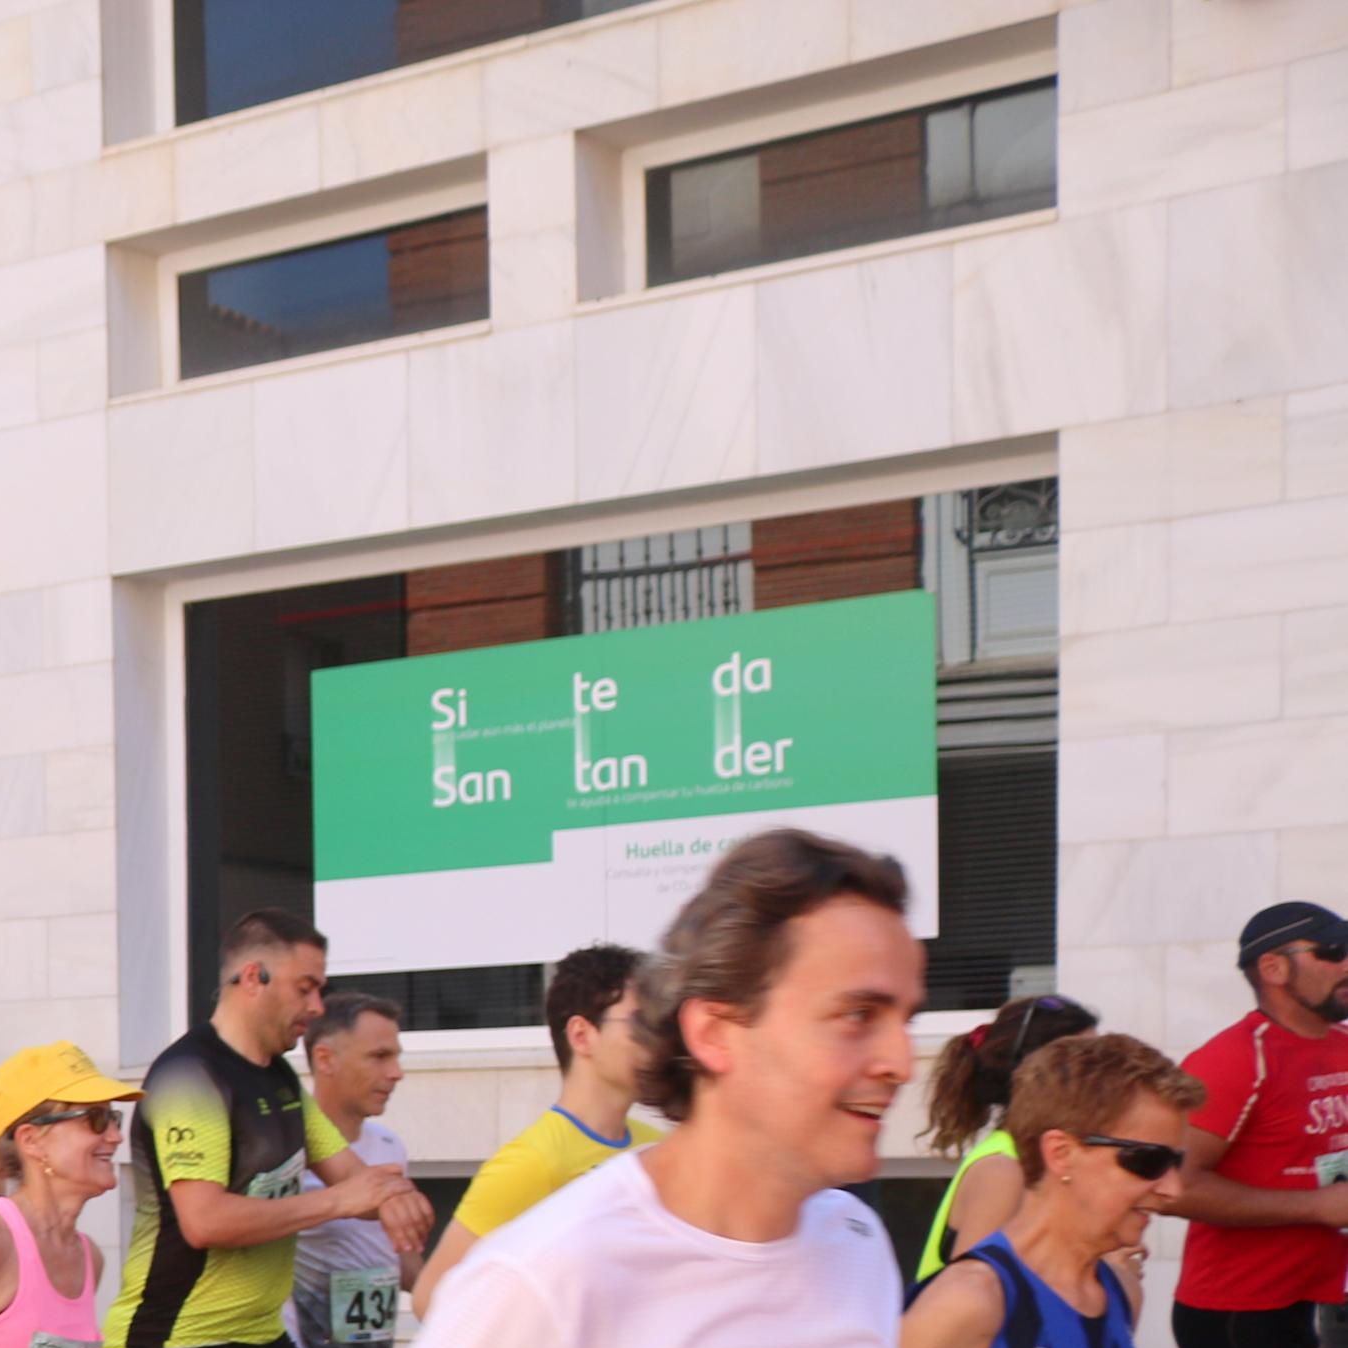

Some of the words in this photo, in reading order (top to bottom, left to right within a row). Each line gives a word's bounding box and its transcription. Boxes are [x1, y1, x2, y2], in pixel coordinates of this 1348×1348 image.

[430, 687, 468, 731] Si
[573, 672, 618, 714] te
[711, 652, 773, 698] da
[432, 766, 512, 809] San
[574, 753, 649, 794] tan
[713, 738, 794, 780] der
[625, 839, 684, 859] Huella
[689, 837, 713, 855] de
